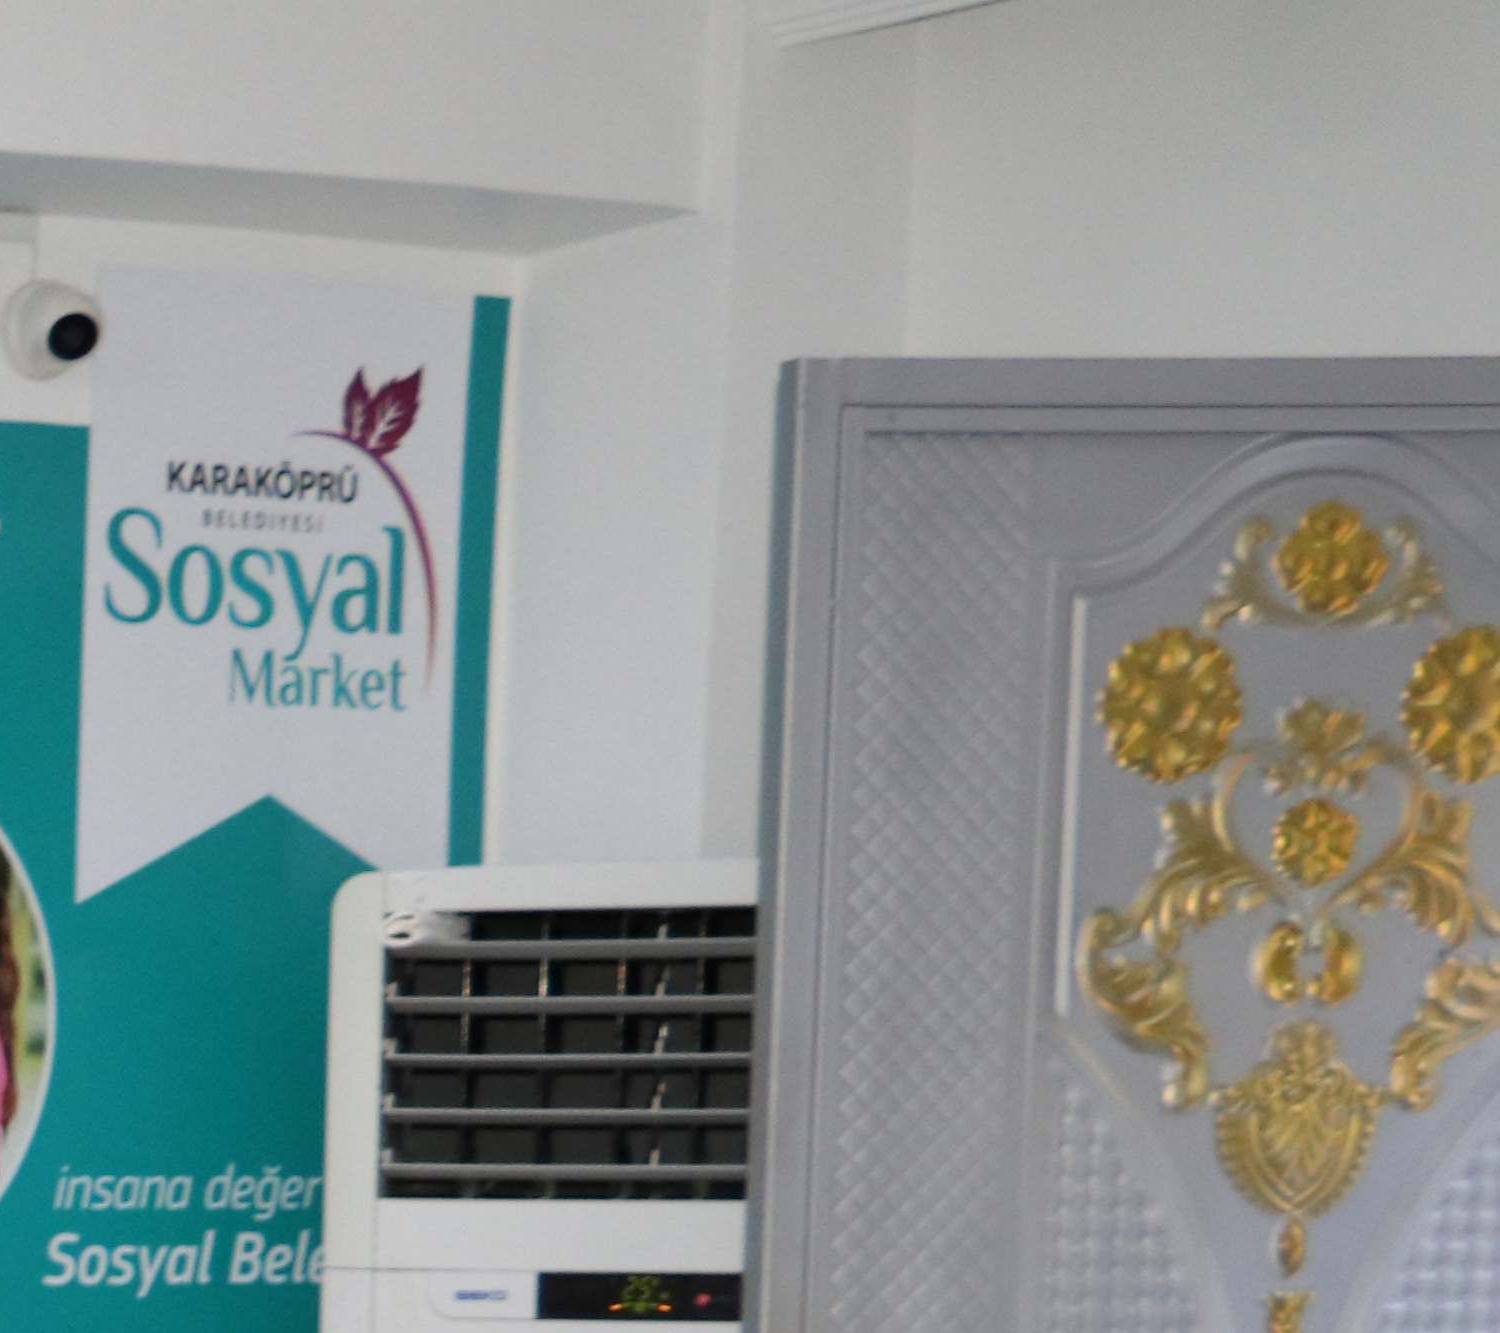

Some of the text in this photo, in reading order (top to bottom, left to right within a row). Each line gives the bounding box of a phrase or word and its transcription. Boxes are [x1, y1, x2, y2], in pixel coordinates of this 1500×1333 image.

[166, 461, 358, 504] KARAKÖPRÜ
[105, 507, 406, 661] Sosyal
[229, 647, 407, 711] Market
[53, 1162, 322, 1222] insana değer
[42, 1229, 216, 1299] Sosyal
